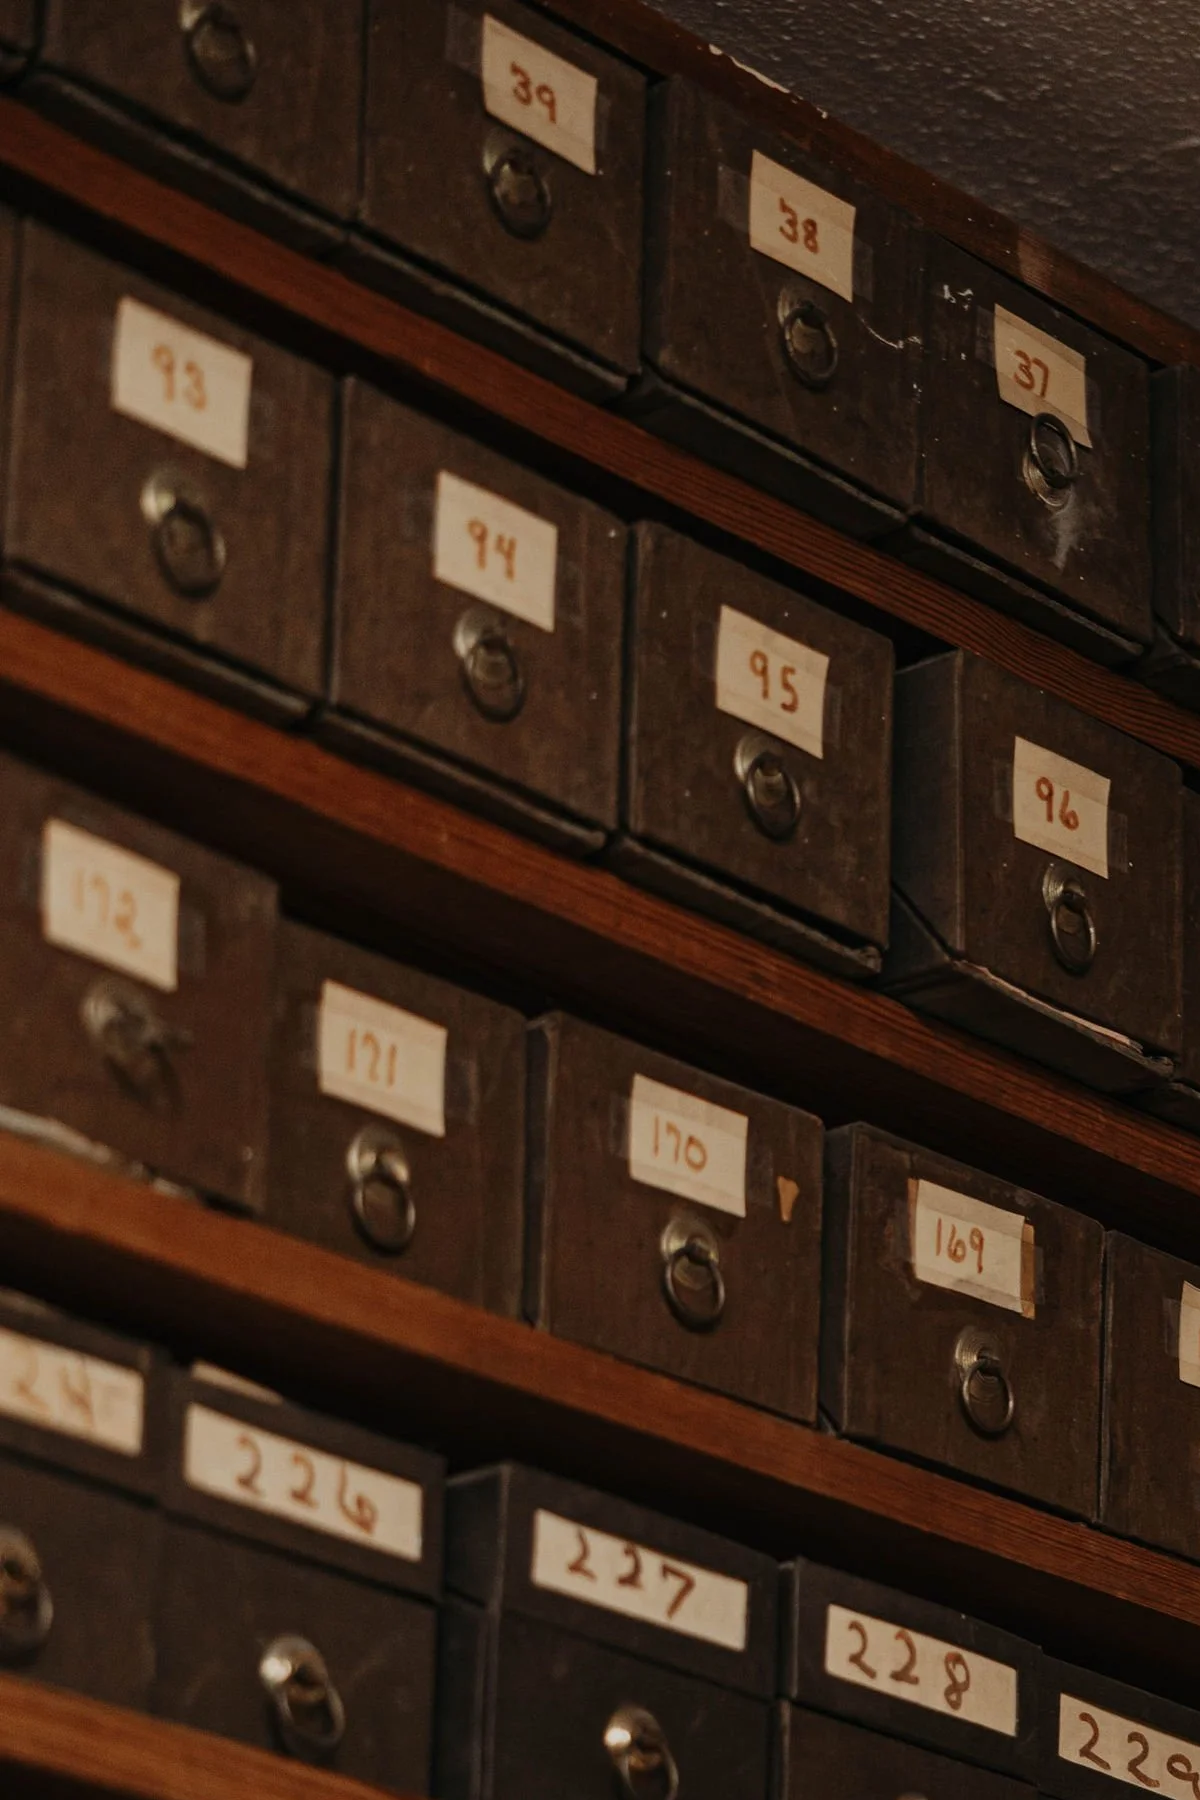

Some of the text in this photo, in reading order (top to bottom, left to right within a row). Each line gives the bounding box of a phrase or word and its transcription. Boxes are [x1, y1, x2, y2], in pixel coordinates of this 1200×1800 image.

[511, 62, 556, 123] 39
[779, 197, 820, 253] 38
[151, 344, 207, 412] 93
[1013, 349, 1051, 397] 37
[467, 518, 517, 583] 94
[749, 650, 798, 713] 95
[1036, 776, 1080, 831] 96
[652, 1116, 707, 1172] 170
[935, 1217, 985, 1275] 169
[238, 1436, 378, 1536] 226
[567, 1527, 696, 1619] 227
[848, 1620, 971, 1711] 228
